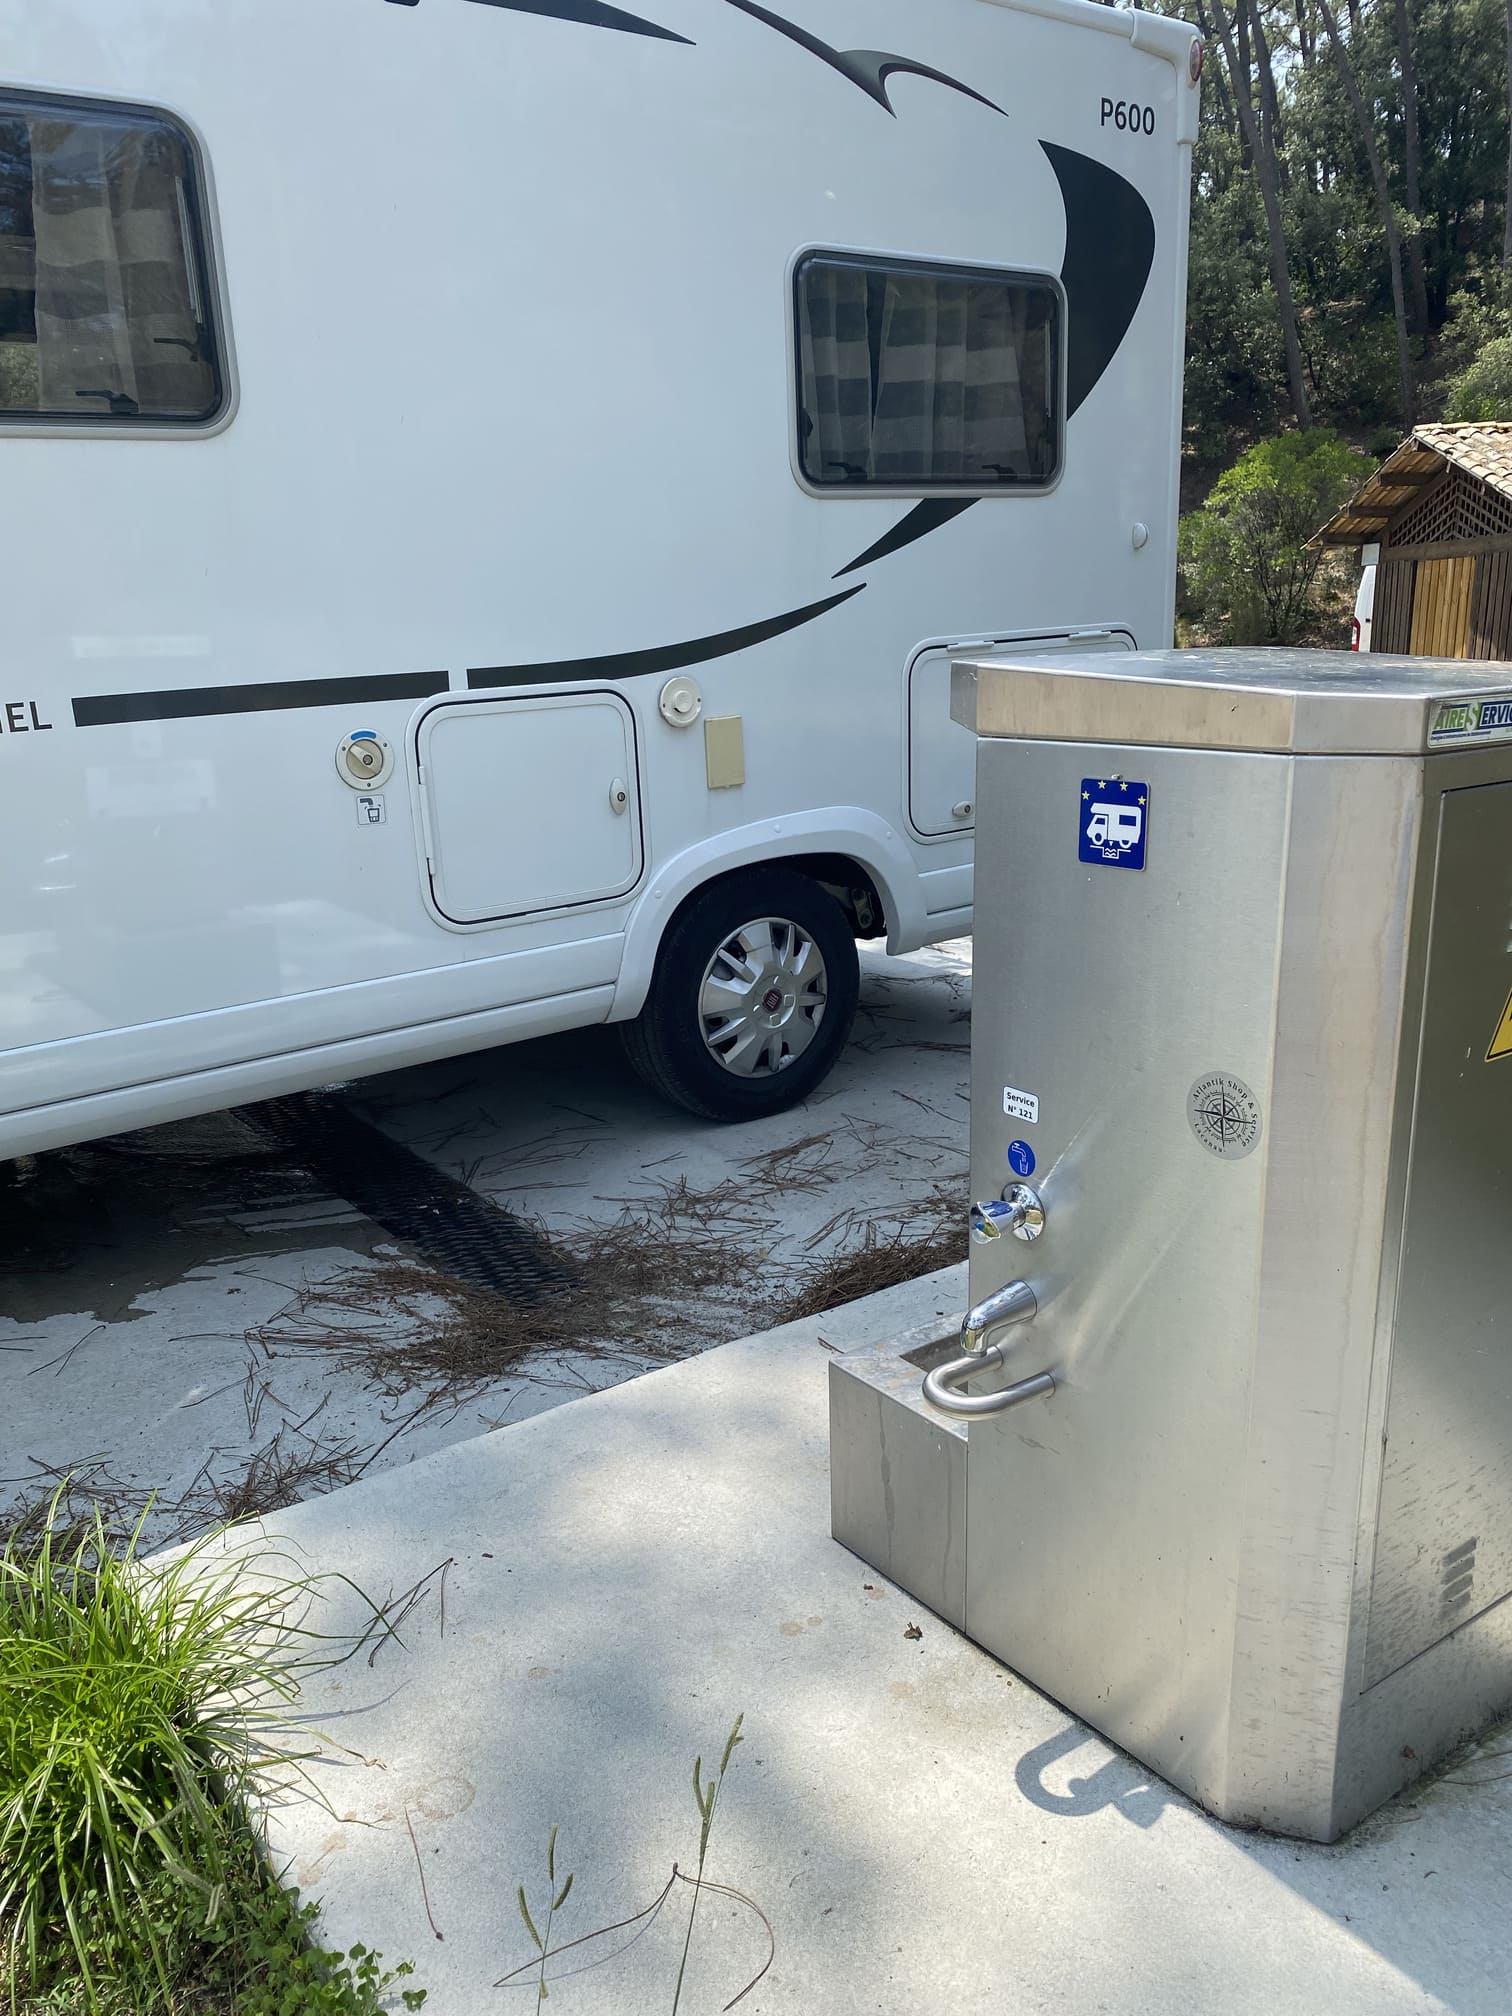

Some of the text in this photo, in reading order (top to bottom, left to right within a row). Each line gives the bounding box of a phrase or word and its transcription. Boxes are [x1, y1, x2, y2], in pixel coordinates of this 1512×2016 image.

[1101, 97, 1155, 135] P600
[0, 701, 52, 733] EL
[1432, 702, 1512, 730] AIRESERVI
[1007, 1091, 1035, 1107] Service
[1019, 1108, 1033, 1120] 121
[1227, 1080, 1248, 1100] Shop
[1241, 1113, 1258, 1147] Service
